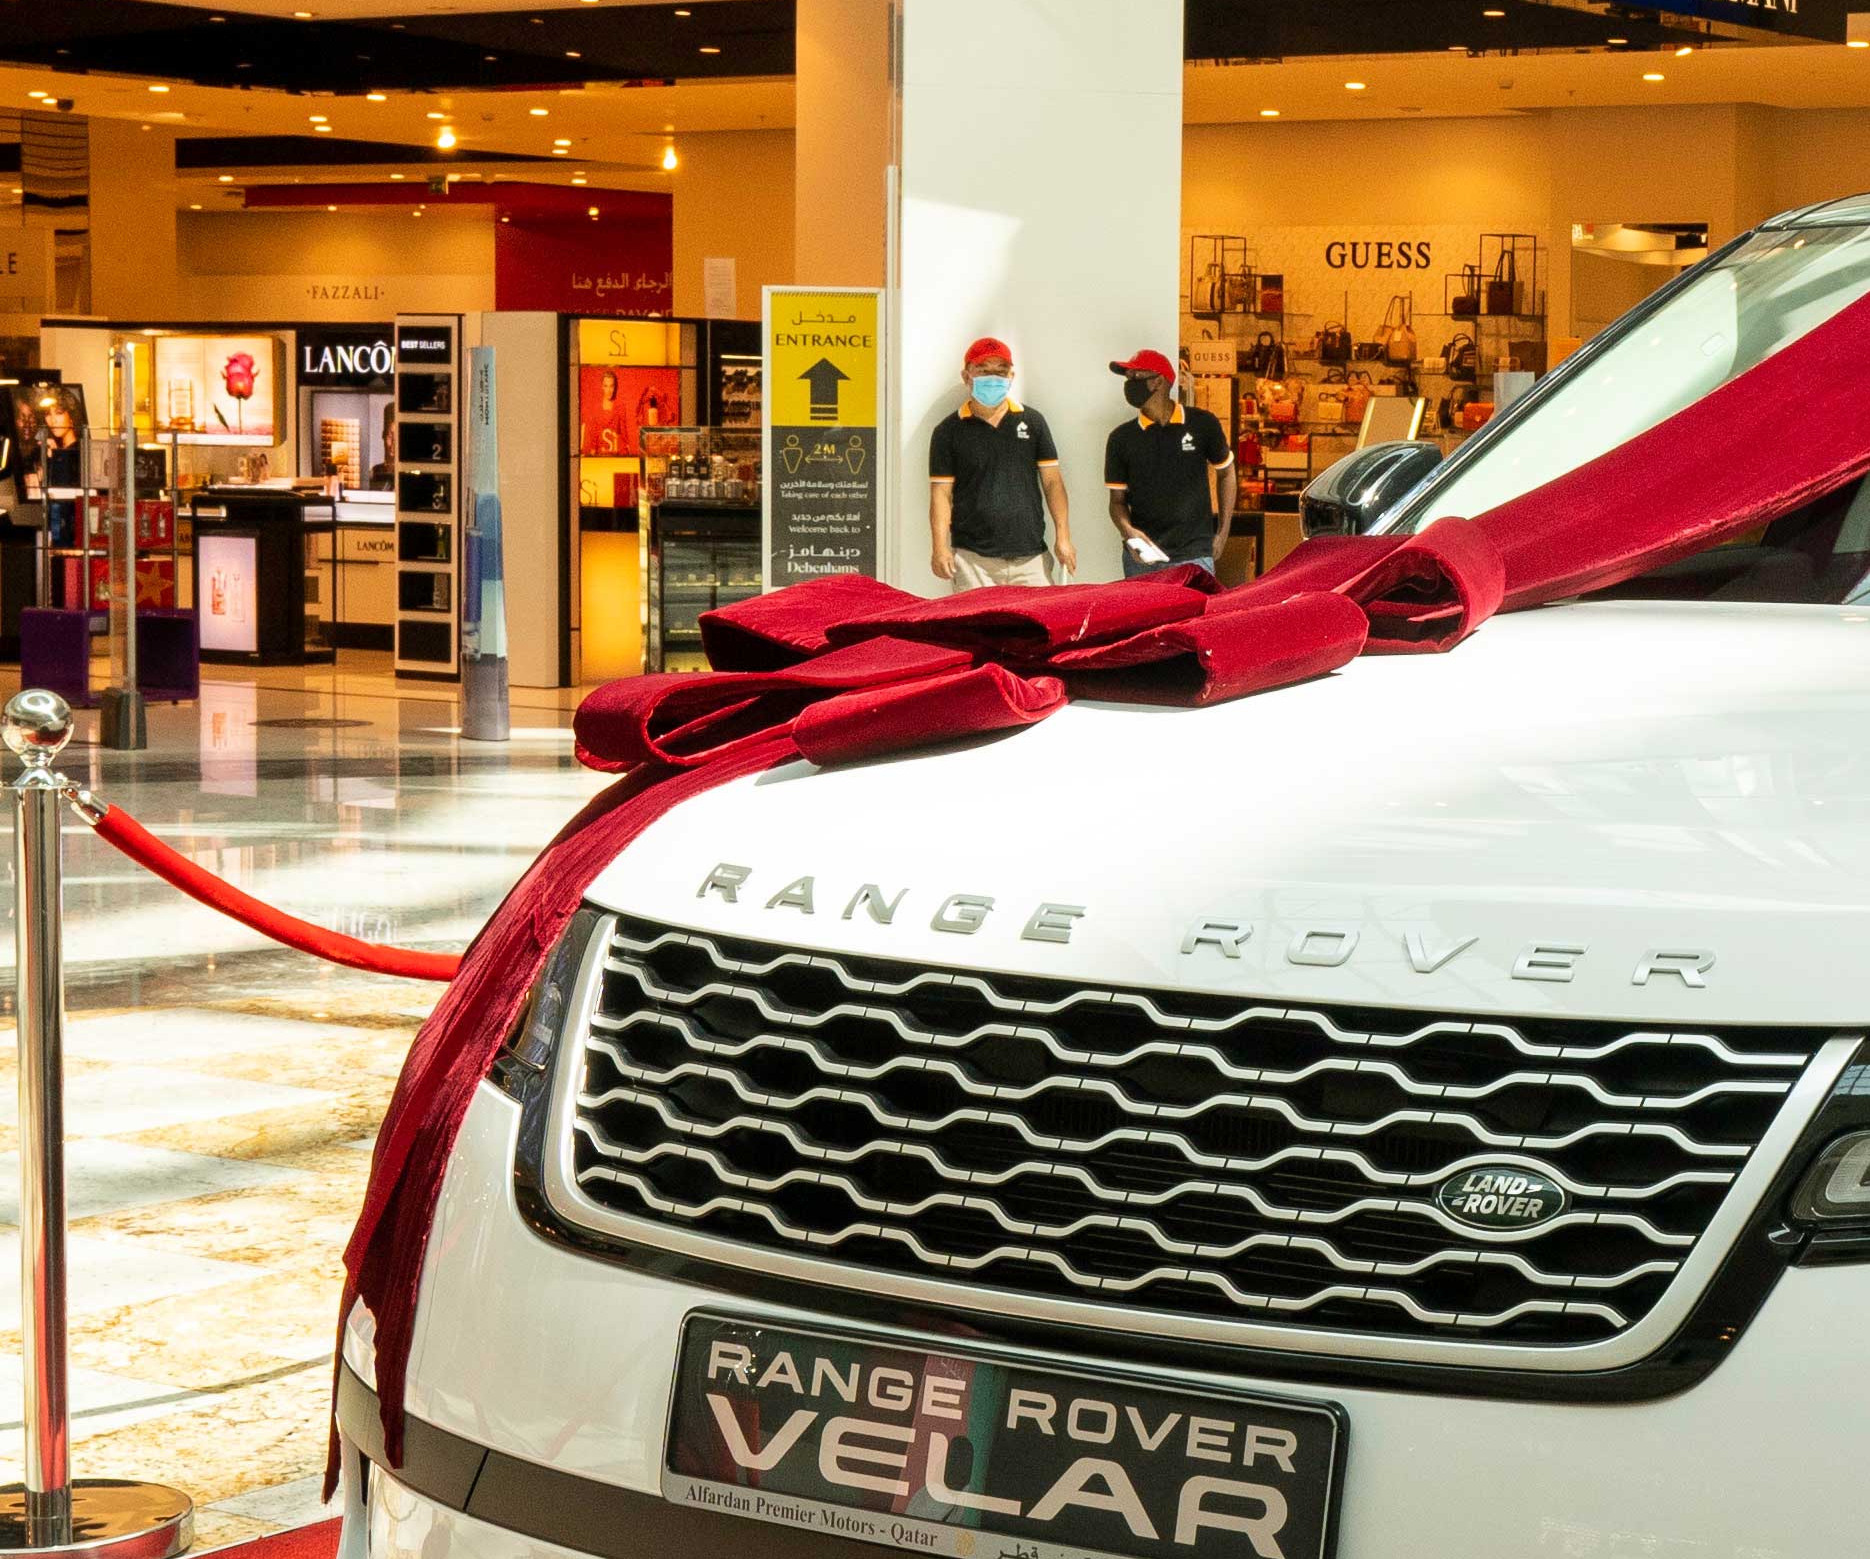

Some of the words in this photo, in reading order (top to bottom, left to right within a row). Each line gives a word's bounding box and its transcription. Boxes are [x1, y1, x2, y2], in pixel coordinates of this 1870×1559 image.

[1326, 241, 1431, 269] GUESS
[572, 272, 592, 290] هنا
[596, 272, 629, 297] الدفع
[791, 310, 856, 326] مدخل
[401, 341, 419, 349] BEST
[419, 341, 446, 350] SELLERS
[775, 333, 873, 348] ENTRANCE
[304, 339, 395, 374] LANCÔ
[1193, 352, 1231, 362] GUESS
[432, 444, 442, 460] 2
[781, 490, 803, 500] Taking
[821, 491, 831, 499] of
[831, 491, 848, 499] each
[848, 491, 868, 499] other
[829, 524, 850, 534] back
[357, 540, 394, 552] LANCÔM
[787, 561, 860, 574] Debenhams
[696, 861, 1087, 944] RANGE
[1179, 919, 1717, 990] ROVER
[1462, 1174, 1528, 1195] LAND
[1462, 1194, 1544, 1219] ROVER
[707, 1339, 971, 1421] RANGE
[1005, 1388, 1298, 1474] ROVER
[685, 1483, 751, 1512] Alfardan
[755, 1496, 816, 1525] Premier
[820, 1508, 875, 1536] Motors
[890, 1522, 938, 1547] Qatar
